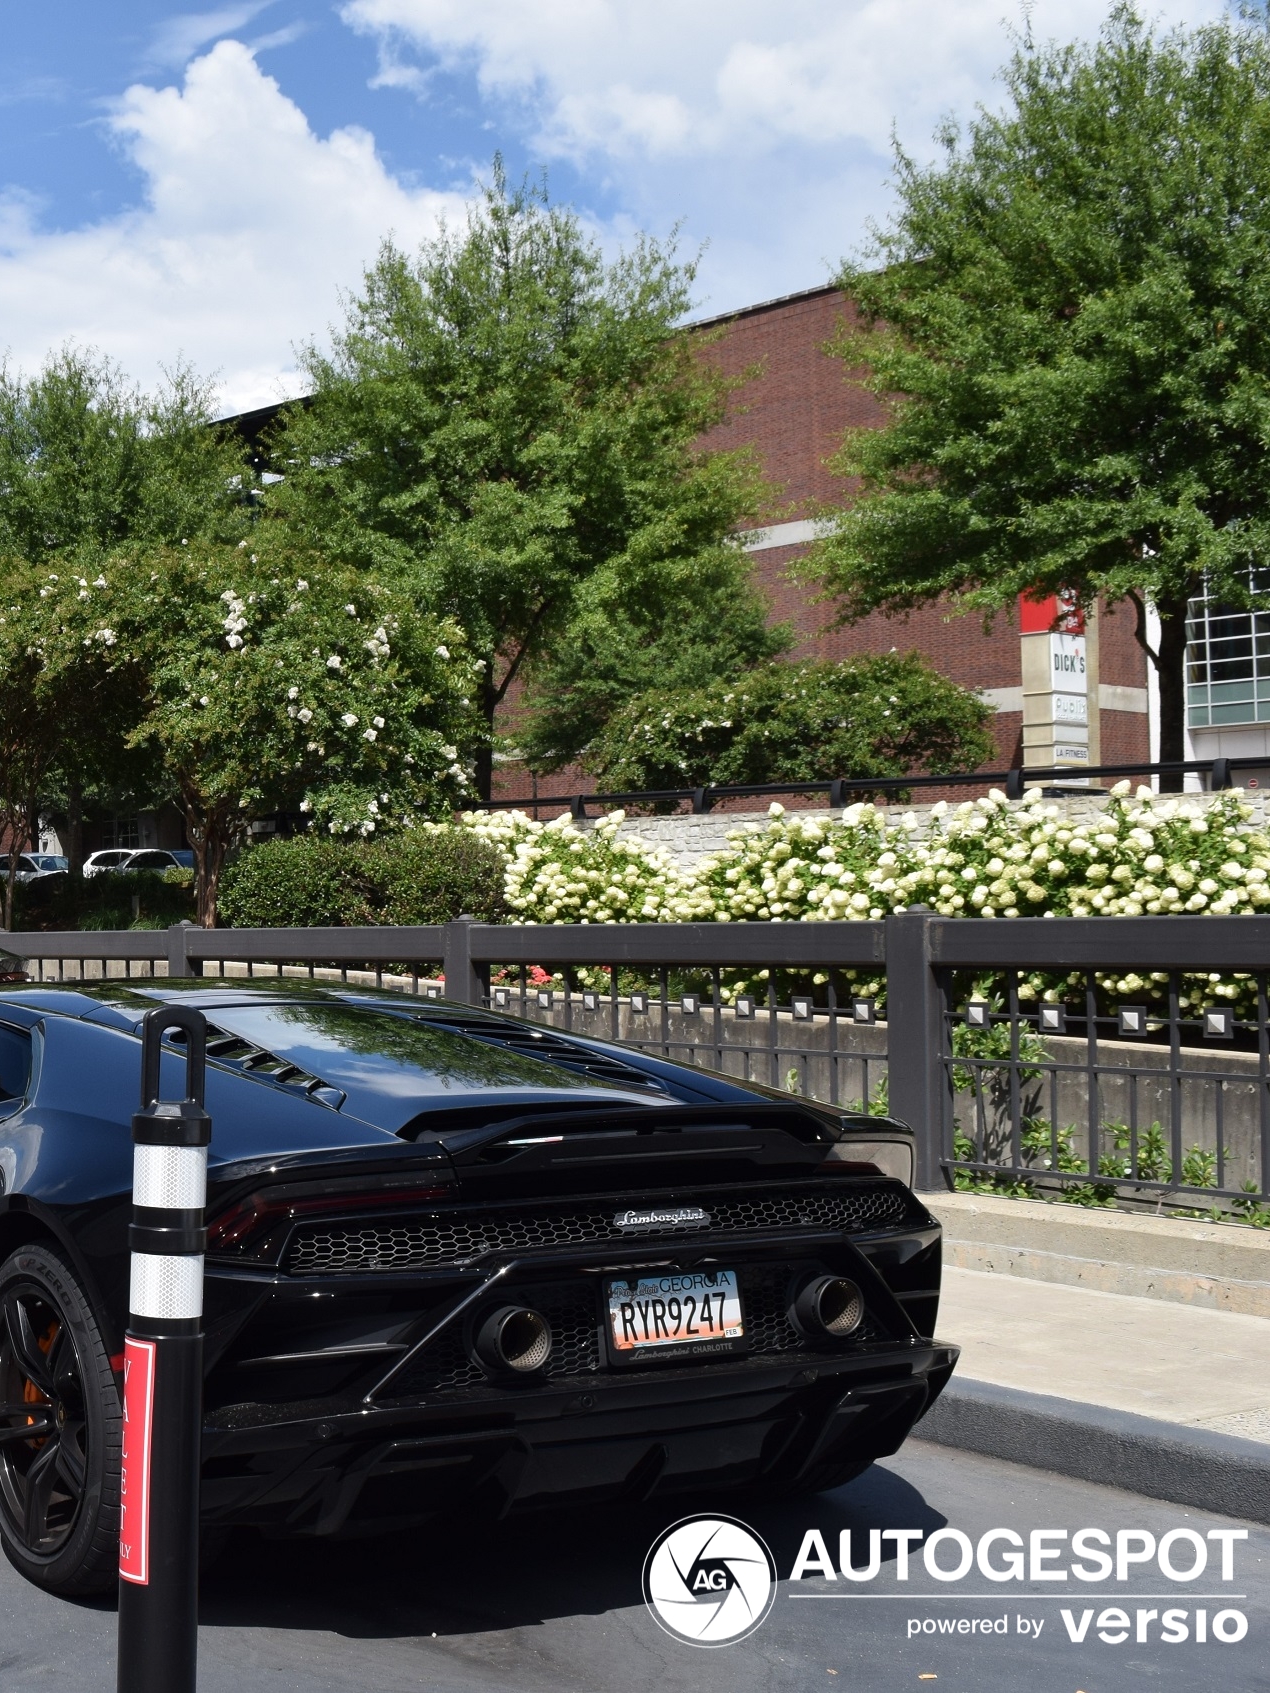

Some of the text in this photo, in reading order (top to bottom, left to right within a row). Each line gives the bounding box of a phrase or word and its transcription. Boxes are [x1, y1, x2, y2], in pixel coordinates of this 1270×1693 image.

[1054, 649, 1085, 673] DICK'S
[1056, 748, 1087, 759] LA FITNESS
[616, 1208, 705, 1227] Lamborghini
[659, 1272, 731, 1293] GEORGIA
[620, 1292, 726, 1342] RYR9247
[725, 1328, 738, 1336] FEB
[629, 1342, 733, 1361] Lamborghini CHARLOTTE
